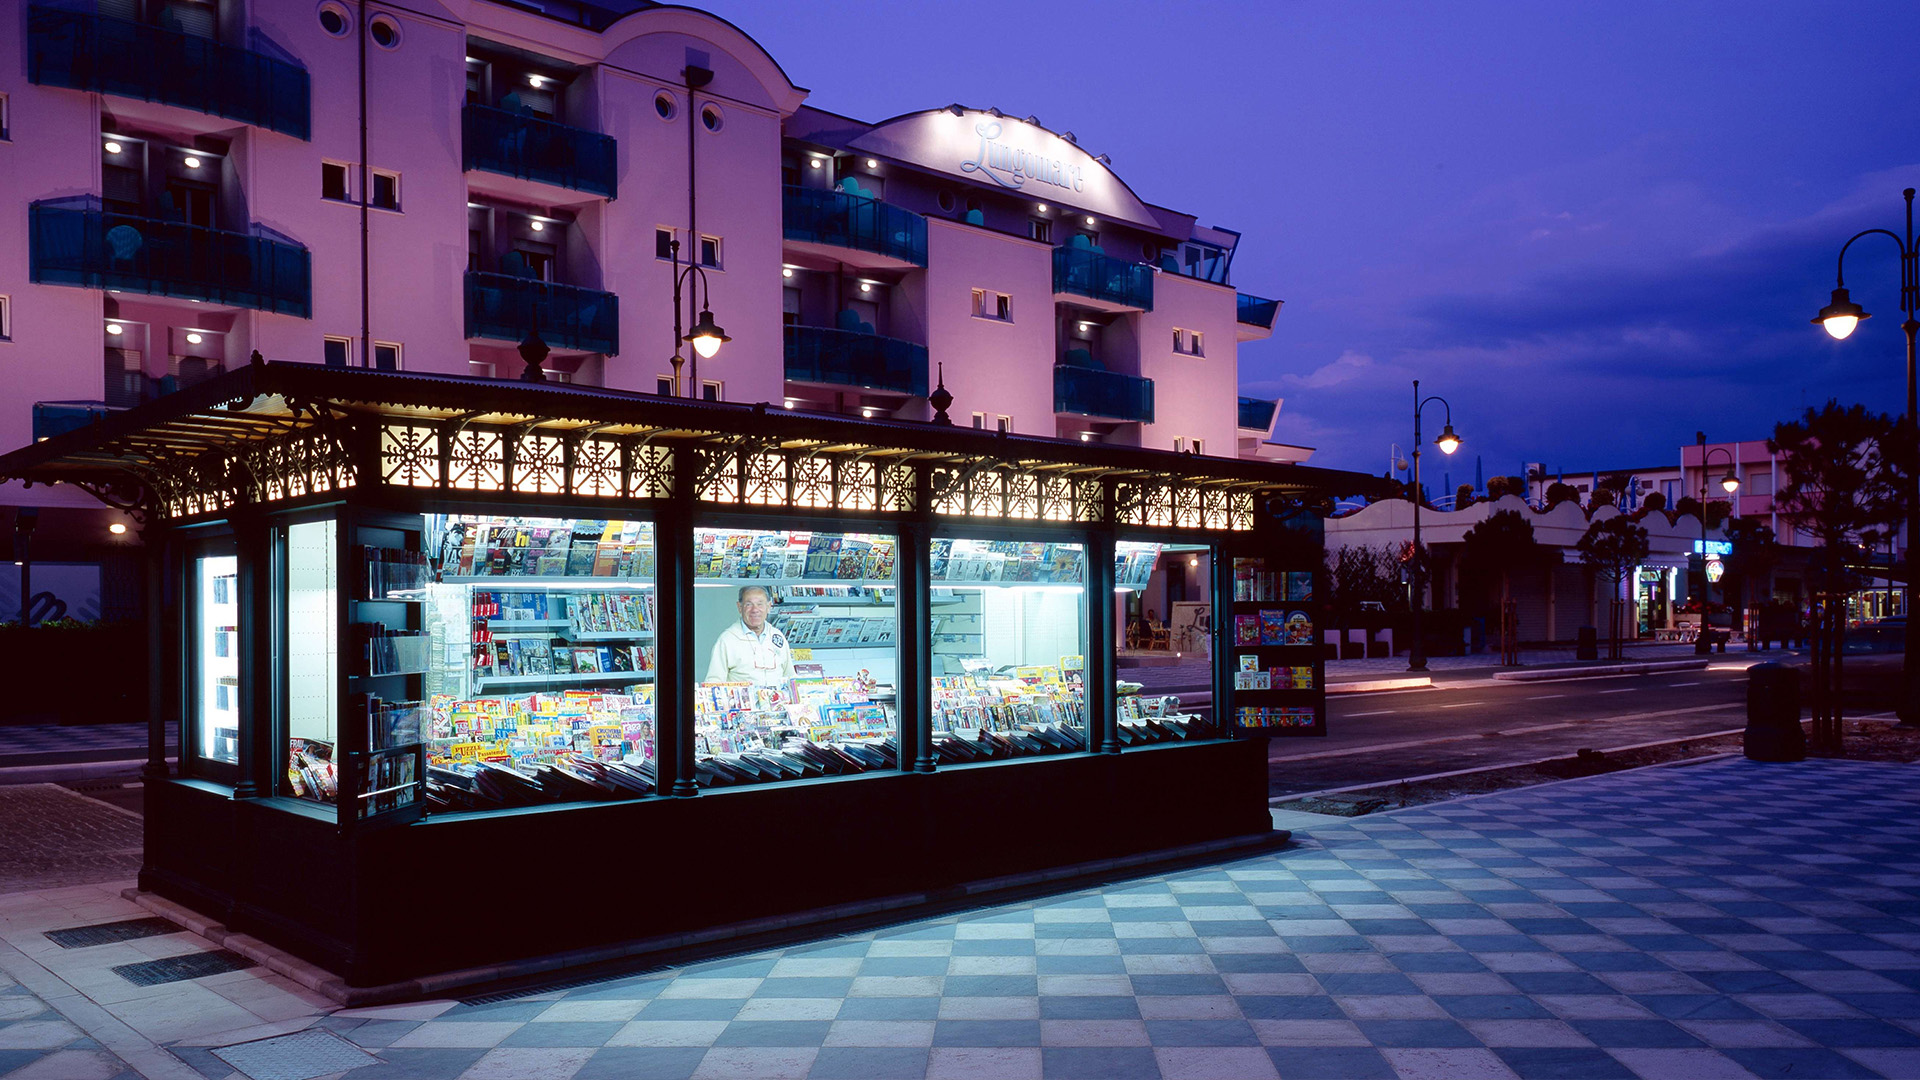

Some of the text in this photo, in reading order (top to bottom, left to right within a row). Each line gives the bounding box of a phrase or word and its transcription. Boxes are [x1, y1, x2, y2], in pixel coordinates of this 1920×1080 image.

[960, 121, 1084, 193] Lungomare
[810, 536, 830, 548] Win
[807, 551, 838, 572] 100
[511, 748, 535, 758] Special
